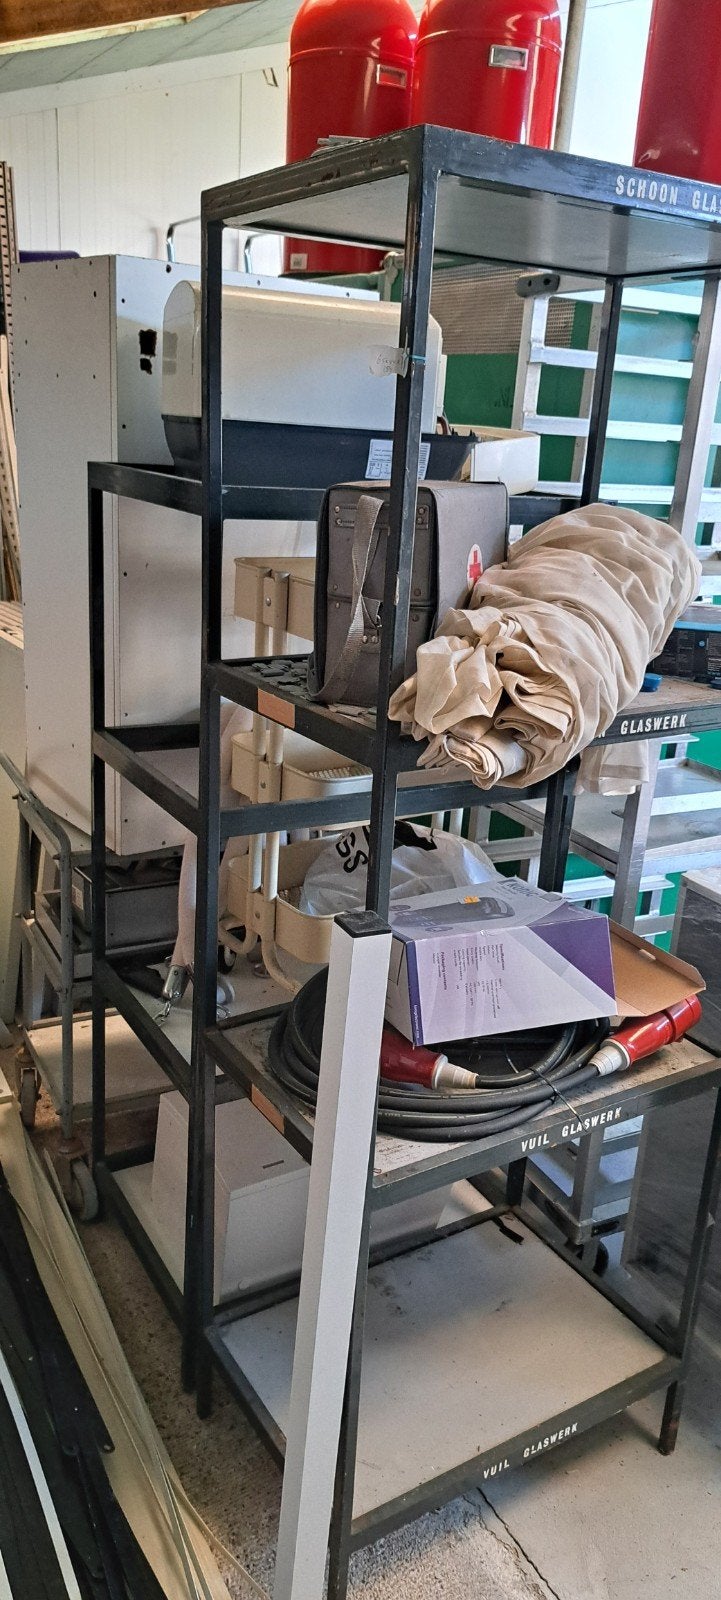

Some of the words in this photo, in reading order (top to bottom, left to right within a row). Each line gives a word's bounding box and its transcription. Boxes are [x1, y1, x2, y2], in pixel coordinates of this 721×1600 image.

[615, 174, 679, 206] SCHOON
[692, 190, 721, 214] GLA
[620, 713, 688, 735] GLASWERK
[521, 1133, 550, 1152] VUIL
[561, 1106, 622, 1138] GLASWERK
[483, 1459, 510, 1479] VUIL
[523, 1422, 578, 1458] GLASWERK
